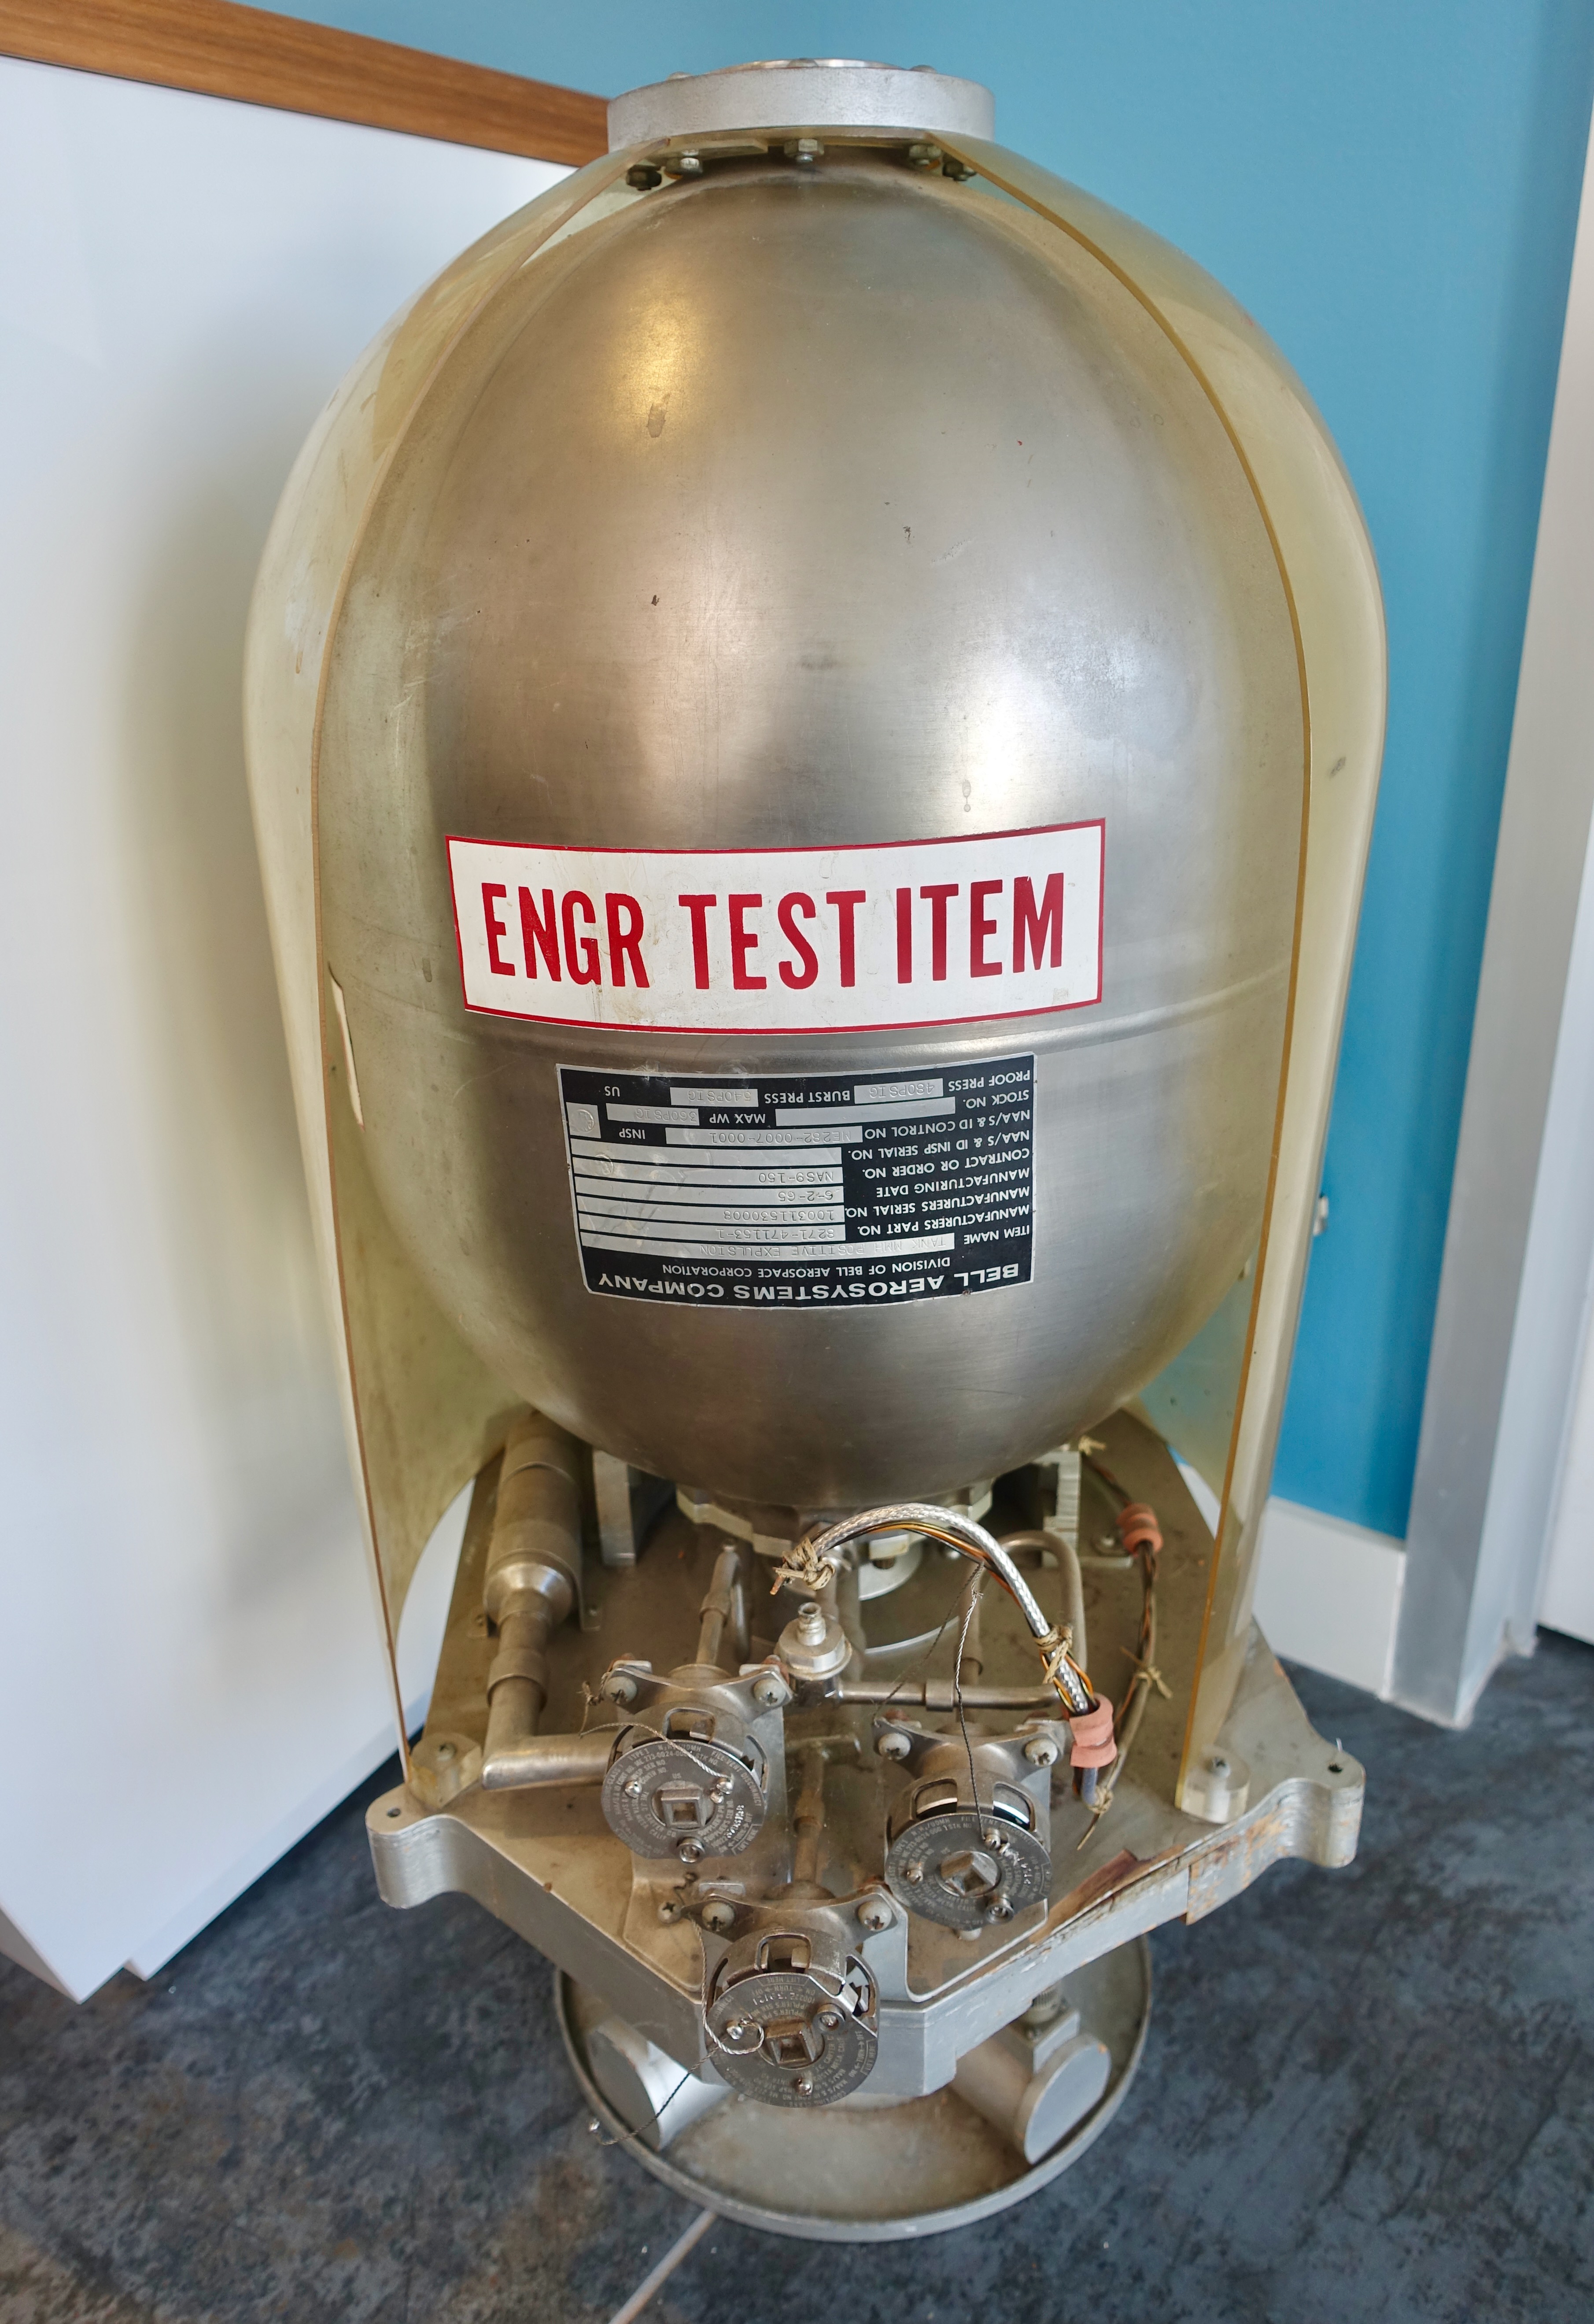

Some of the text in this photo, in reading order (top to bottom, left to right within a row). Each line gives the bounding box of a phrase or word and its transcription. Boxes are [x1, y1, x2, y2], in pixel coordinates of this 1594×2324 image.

[482, 873, 1063, 990] ENGR TEST ITEM
[604, 1086, 620, 1097] US
[869, 1069, 1030, 1097] PROOF PRESS 480PSIG
[764, 1092, 803, 1104] PRESS
[808, 1090, 850, 1102] BURST
[963, 1089, 1029, 1108] STOCK NO.
[635, 1108, 766, 1124] MAX WP 360PSIG
[709, 1109, 1030, 1144] NAA/S & ID CONTROL NO ME282-0007-0001
[619, 1127, 645, 1140] INSP
[848, 1130, 1030, 1160] NAA/S & ID INSP SERIAL NO.
[940, 1159, 959, 1171] OR
[965, 1147, 1030, 1168] CONTRACT
[862, 1168, 886, 1179] NO.
[892, 1161, 935, 1177] ORDER
[778, 1167, 1029, 1202] MANUFACTURING DATE 6-2-65
[723, 1186, 1029, 1221] MANUFACTURERS SERIAL NO. 100311530008
[716, 1204, 1029, 1240] MANUFACTURERS PART NO. 8271-471153-1
[700, 1224, 1029, 1257] ITEM NAME TANK MMH POSITIVE EXPULSION
[662, 1257, 950, 1278] DIVISION OF BELL AEROSPACE CORPORATION
[598, 1263, 1018, 1300] BELL AEROSYSTEMS COMPANY
